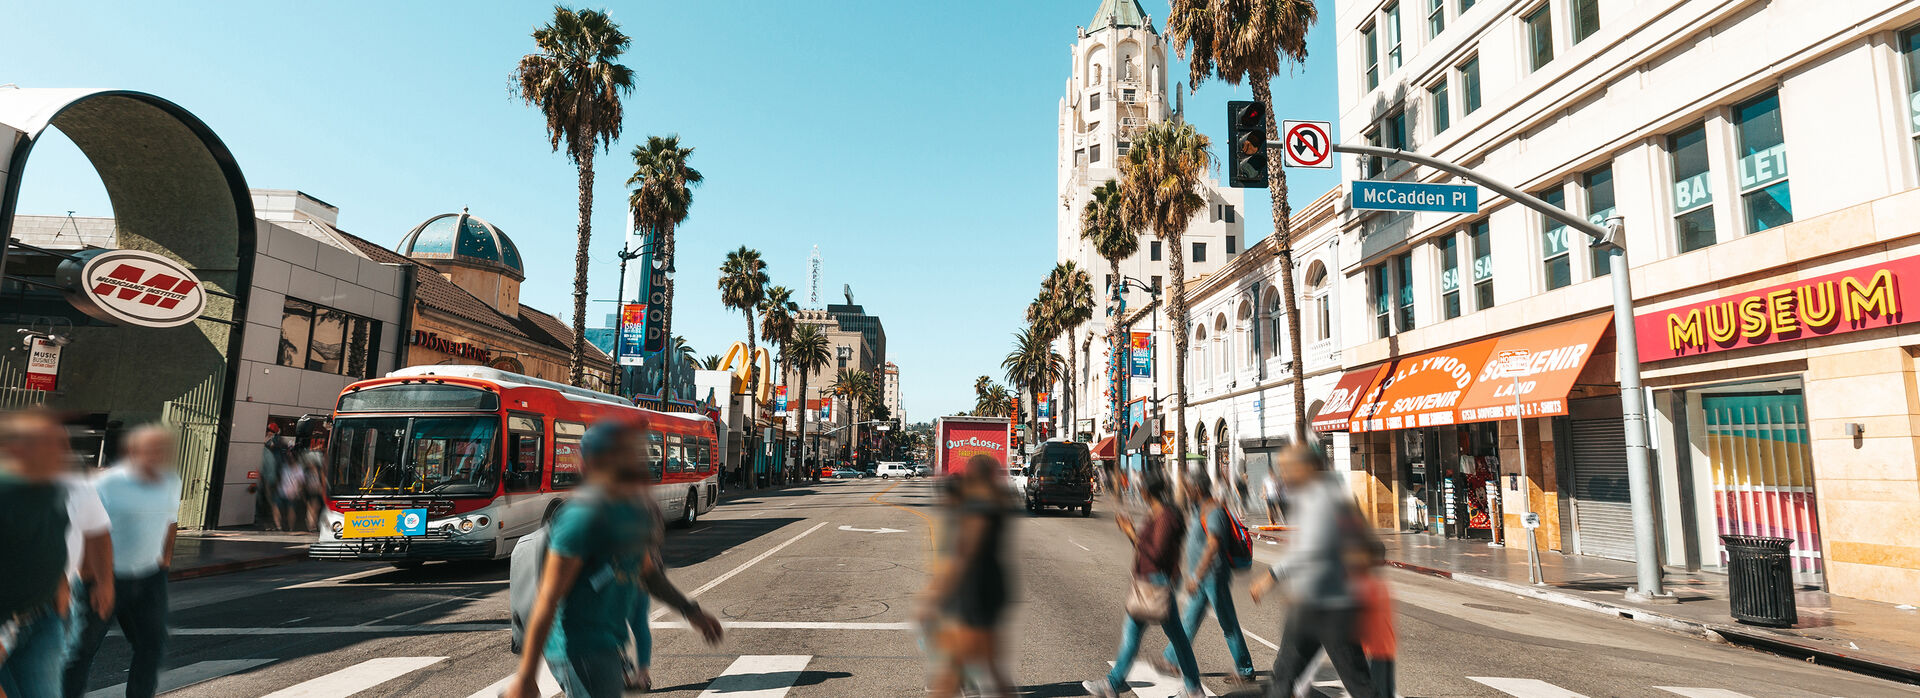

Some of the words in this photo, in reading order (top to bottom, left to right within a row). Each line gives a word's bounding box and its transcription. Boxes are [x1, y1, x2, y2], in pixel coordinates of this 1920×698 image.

[1364, 188, 1445, 206] McCadden
[1452, 192, 1466, 206] Pl
[96, 276, 146, 291] MUSICIANS
[146, 287, 187, 300] INSTITUTE
[1667, 269, 1898, 351] MUSEUM
[34, 351, 57, 359] MUSIC
[1480, 343, 1588, 382] SOVENIR
[1367, 356, 1472, 403] HOLLYWOOD
[1355, 401, 1388, 418] BEST
[1390, 390, 1461, 414] SOUVENIR
[946, 440, 964, 449] OUT
[970, 436, 1000, 450] CLOSET
[352, 519, 384, 527] WOW!
